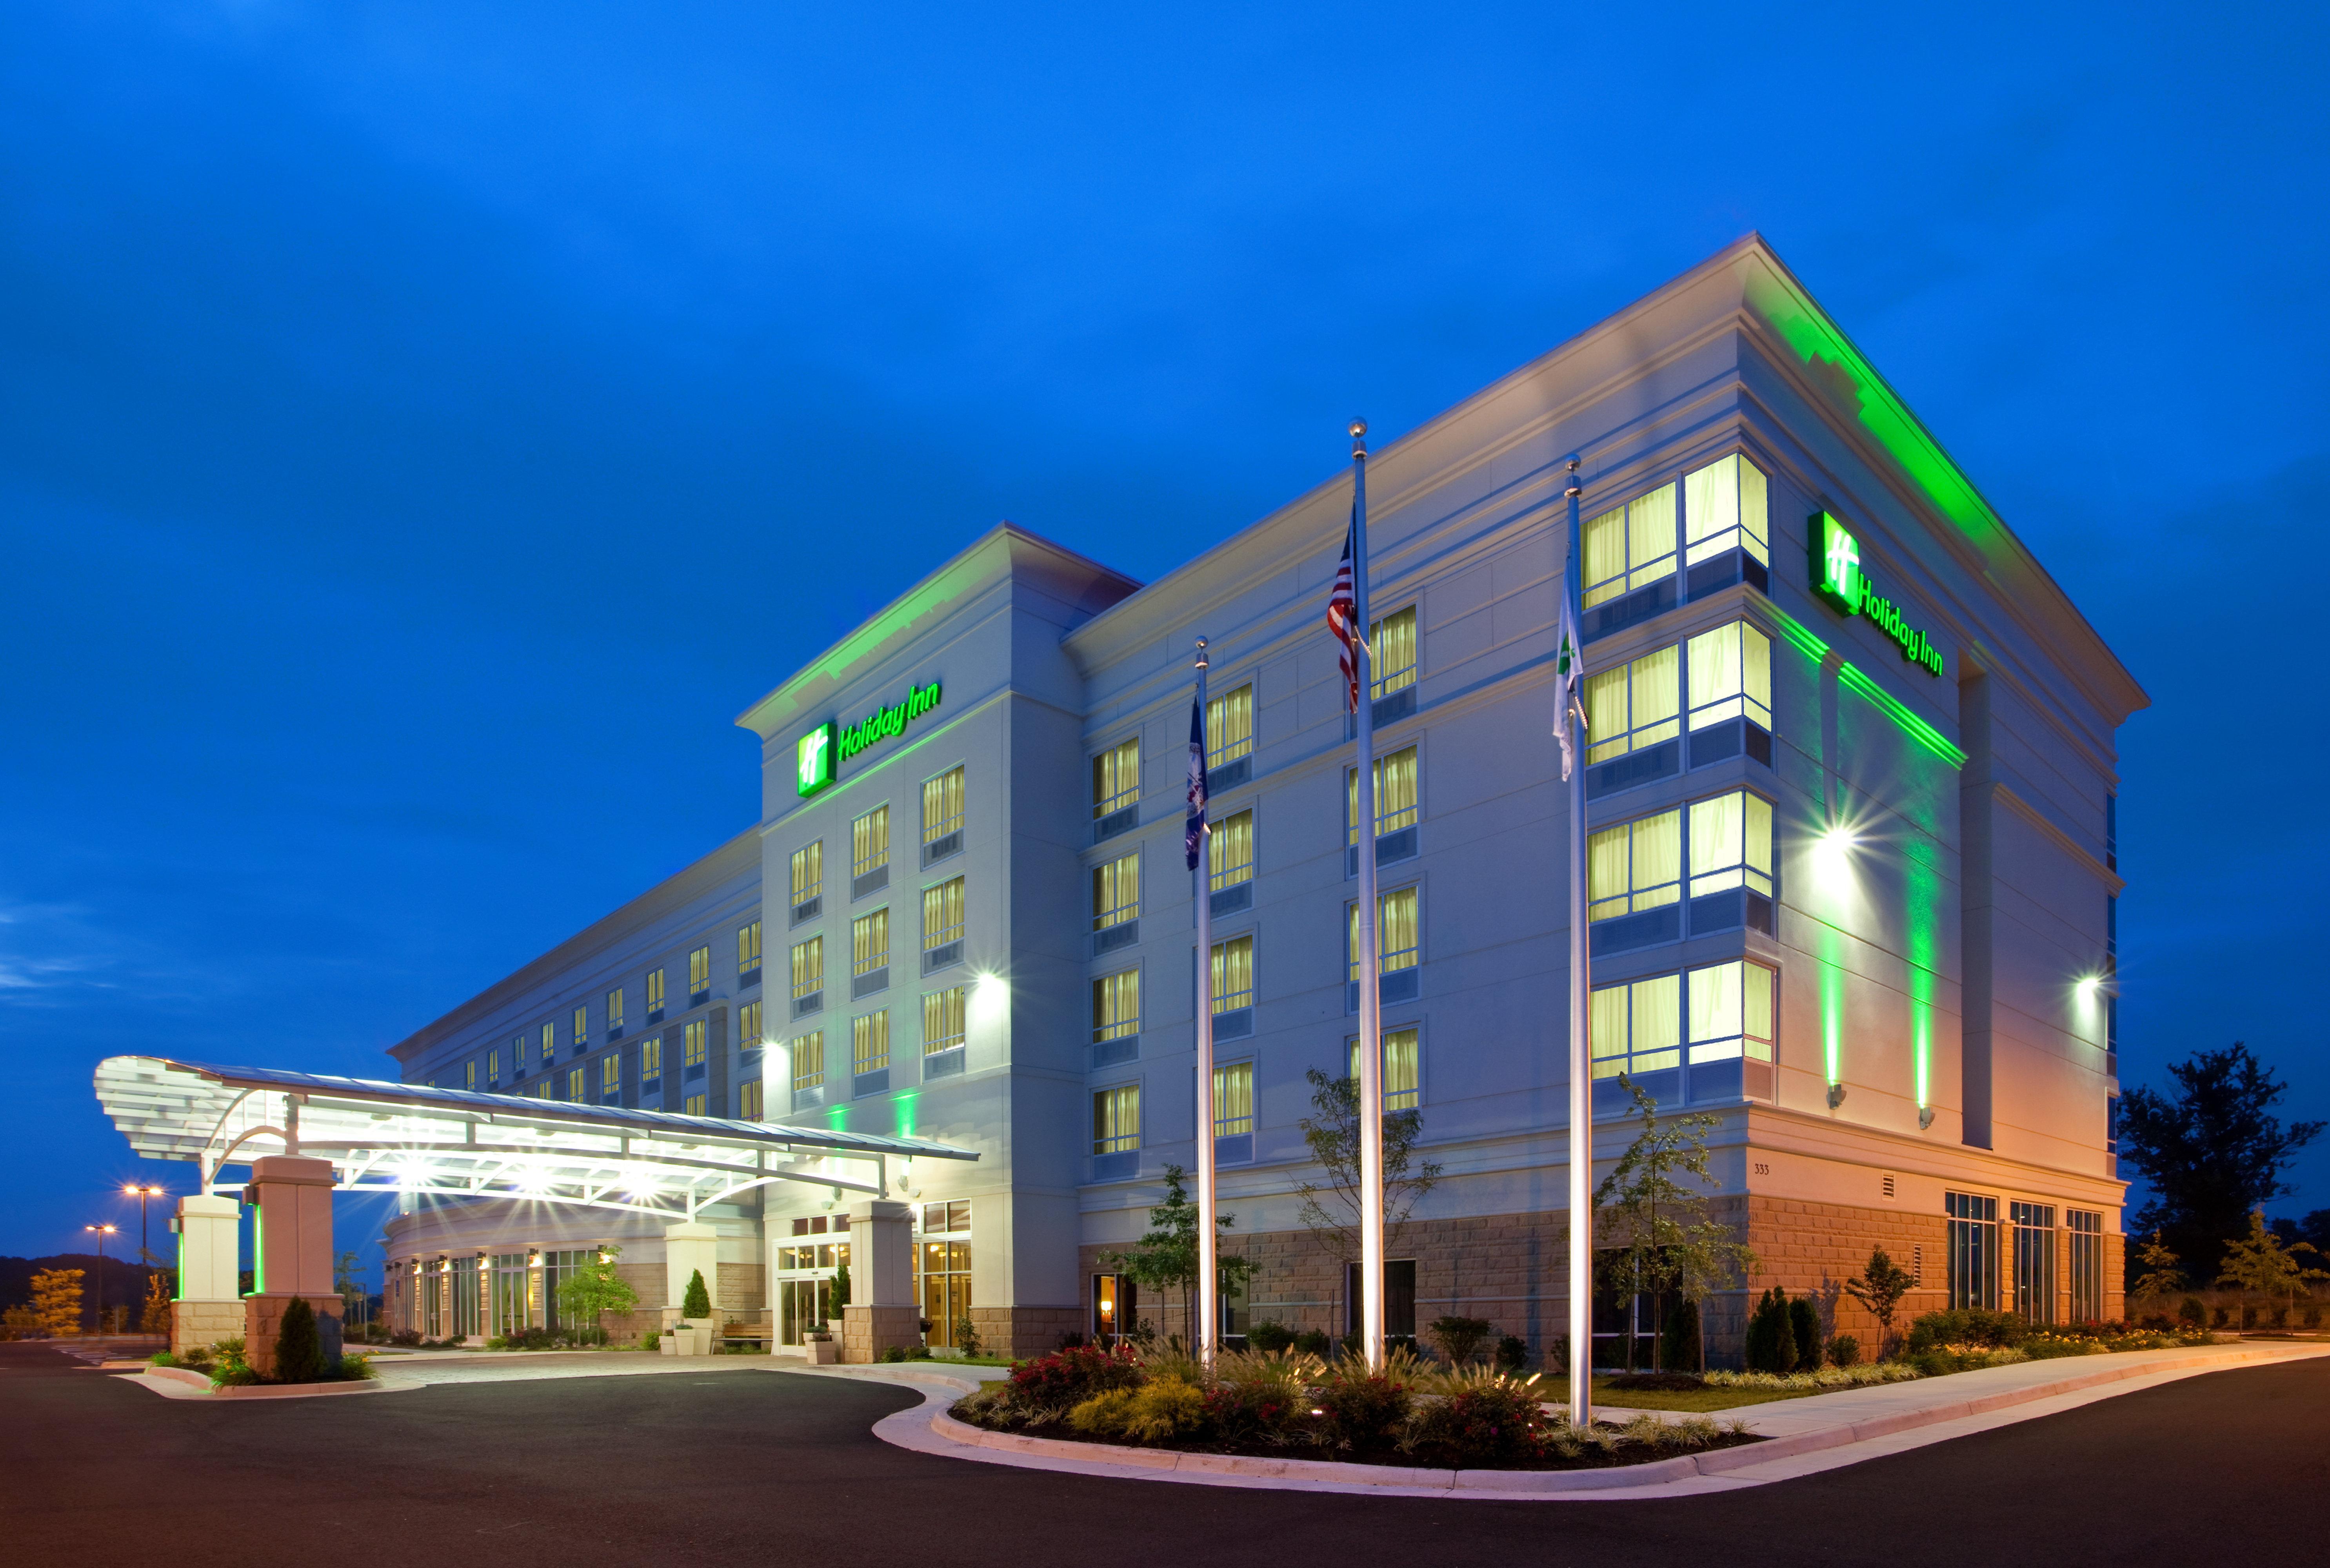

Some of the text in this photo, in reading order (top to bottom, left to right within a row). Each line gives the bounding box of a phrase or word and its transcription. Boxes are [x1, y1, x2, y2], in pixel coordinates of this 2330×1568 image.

[1859, 573, 1944, 677] Holiday Inn
[838, 682, 940, 761] Holiday Inn
[1755, 1163, 1769, 1175] 333
